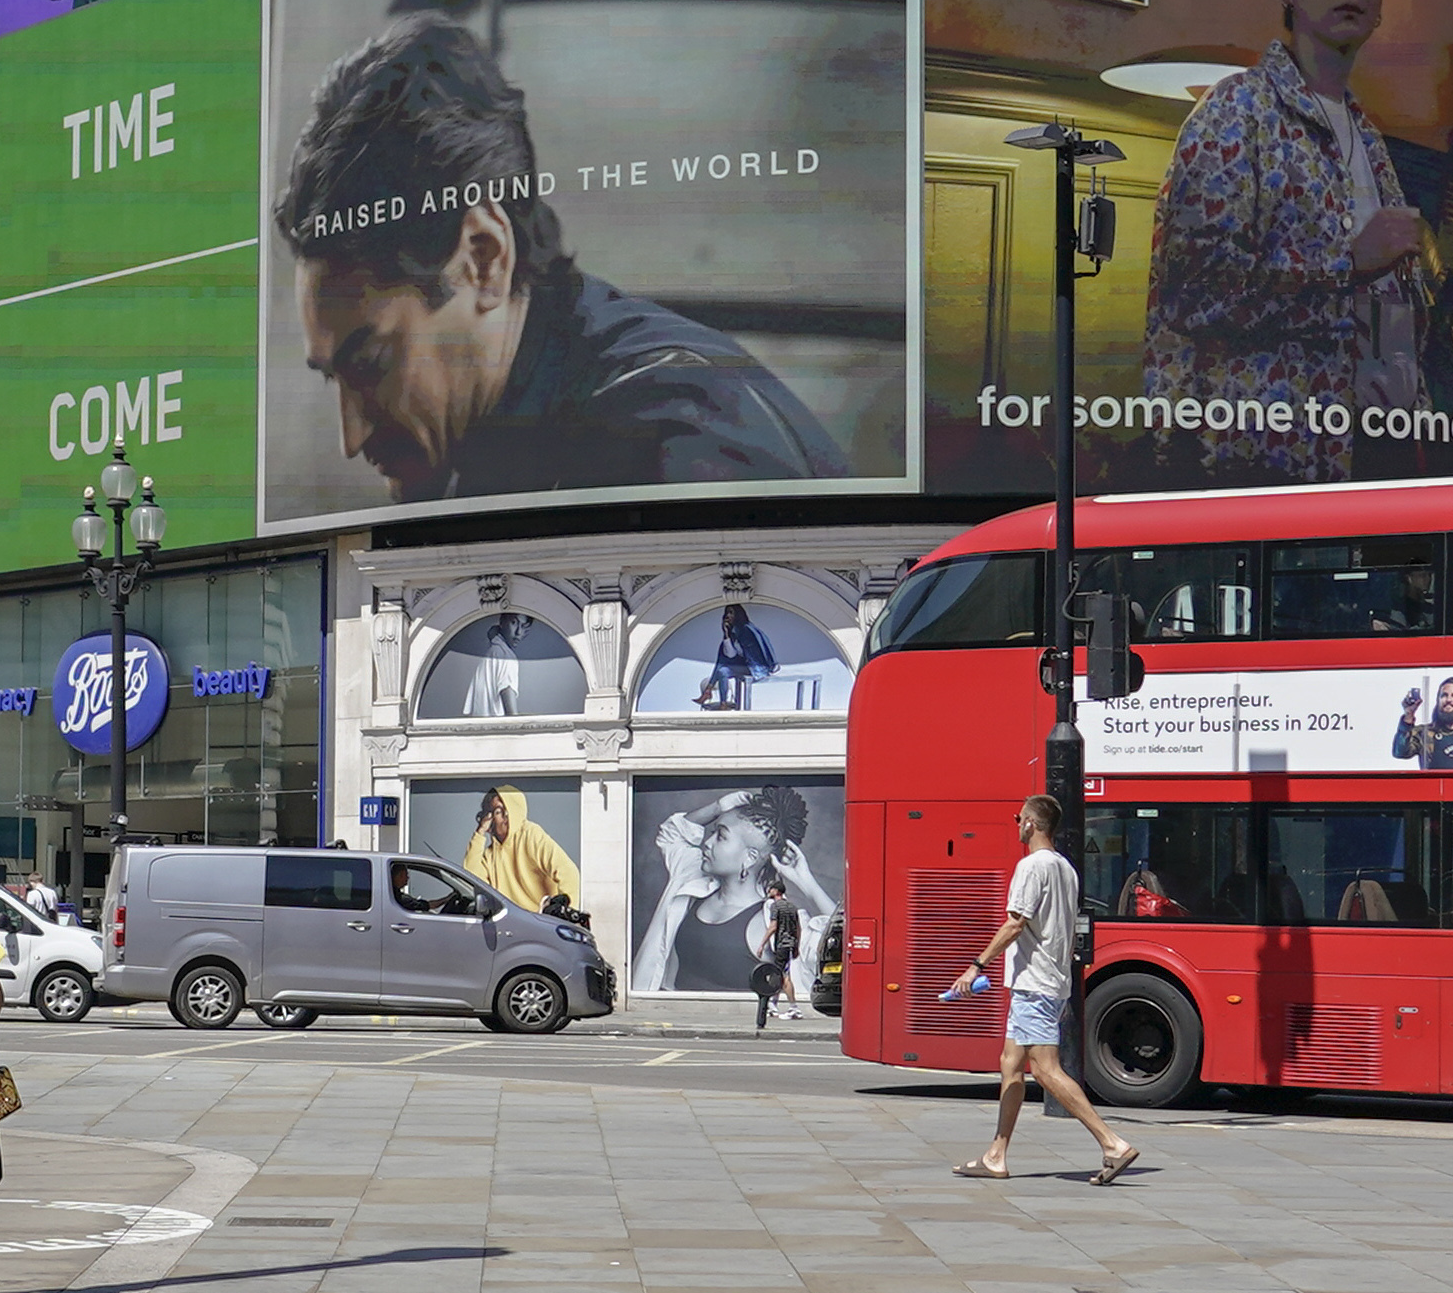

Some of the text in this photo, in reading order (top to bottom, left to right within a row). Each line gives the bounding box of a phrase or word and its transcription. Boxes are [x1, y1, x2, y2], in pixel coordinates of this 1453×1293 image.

[62, 82, 176, 180] TIME
[314, 148, 821, 239] RAISED AROUND THE WORLD
[48, 368, 185, 463] COME
[976, 385, 1050, 428] for
[1073, 392, 1294, 434] someone
[1304, 395, 1351, 439] to
[193, 661, 271, 699] beauty
[1104, 693, 1273, 713] Rise, entrepreneur.
[1103, 713, 1354, 737] Start your business in 2021.
[1103, 743, 1203, 755] Sign up at tide.co/start
[363, 803, 379, 818] GAP
